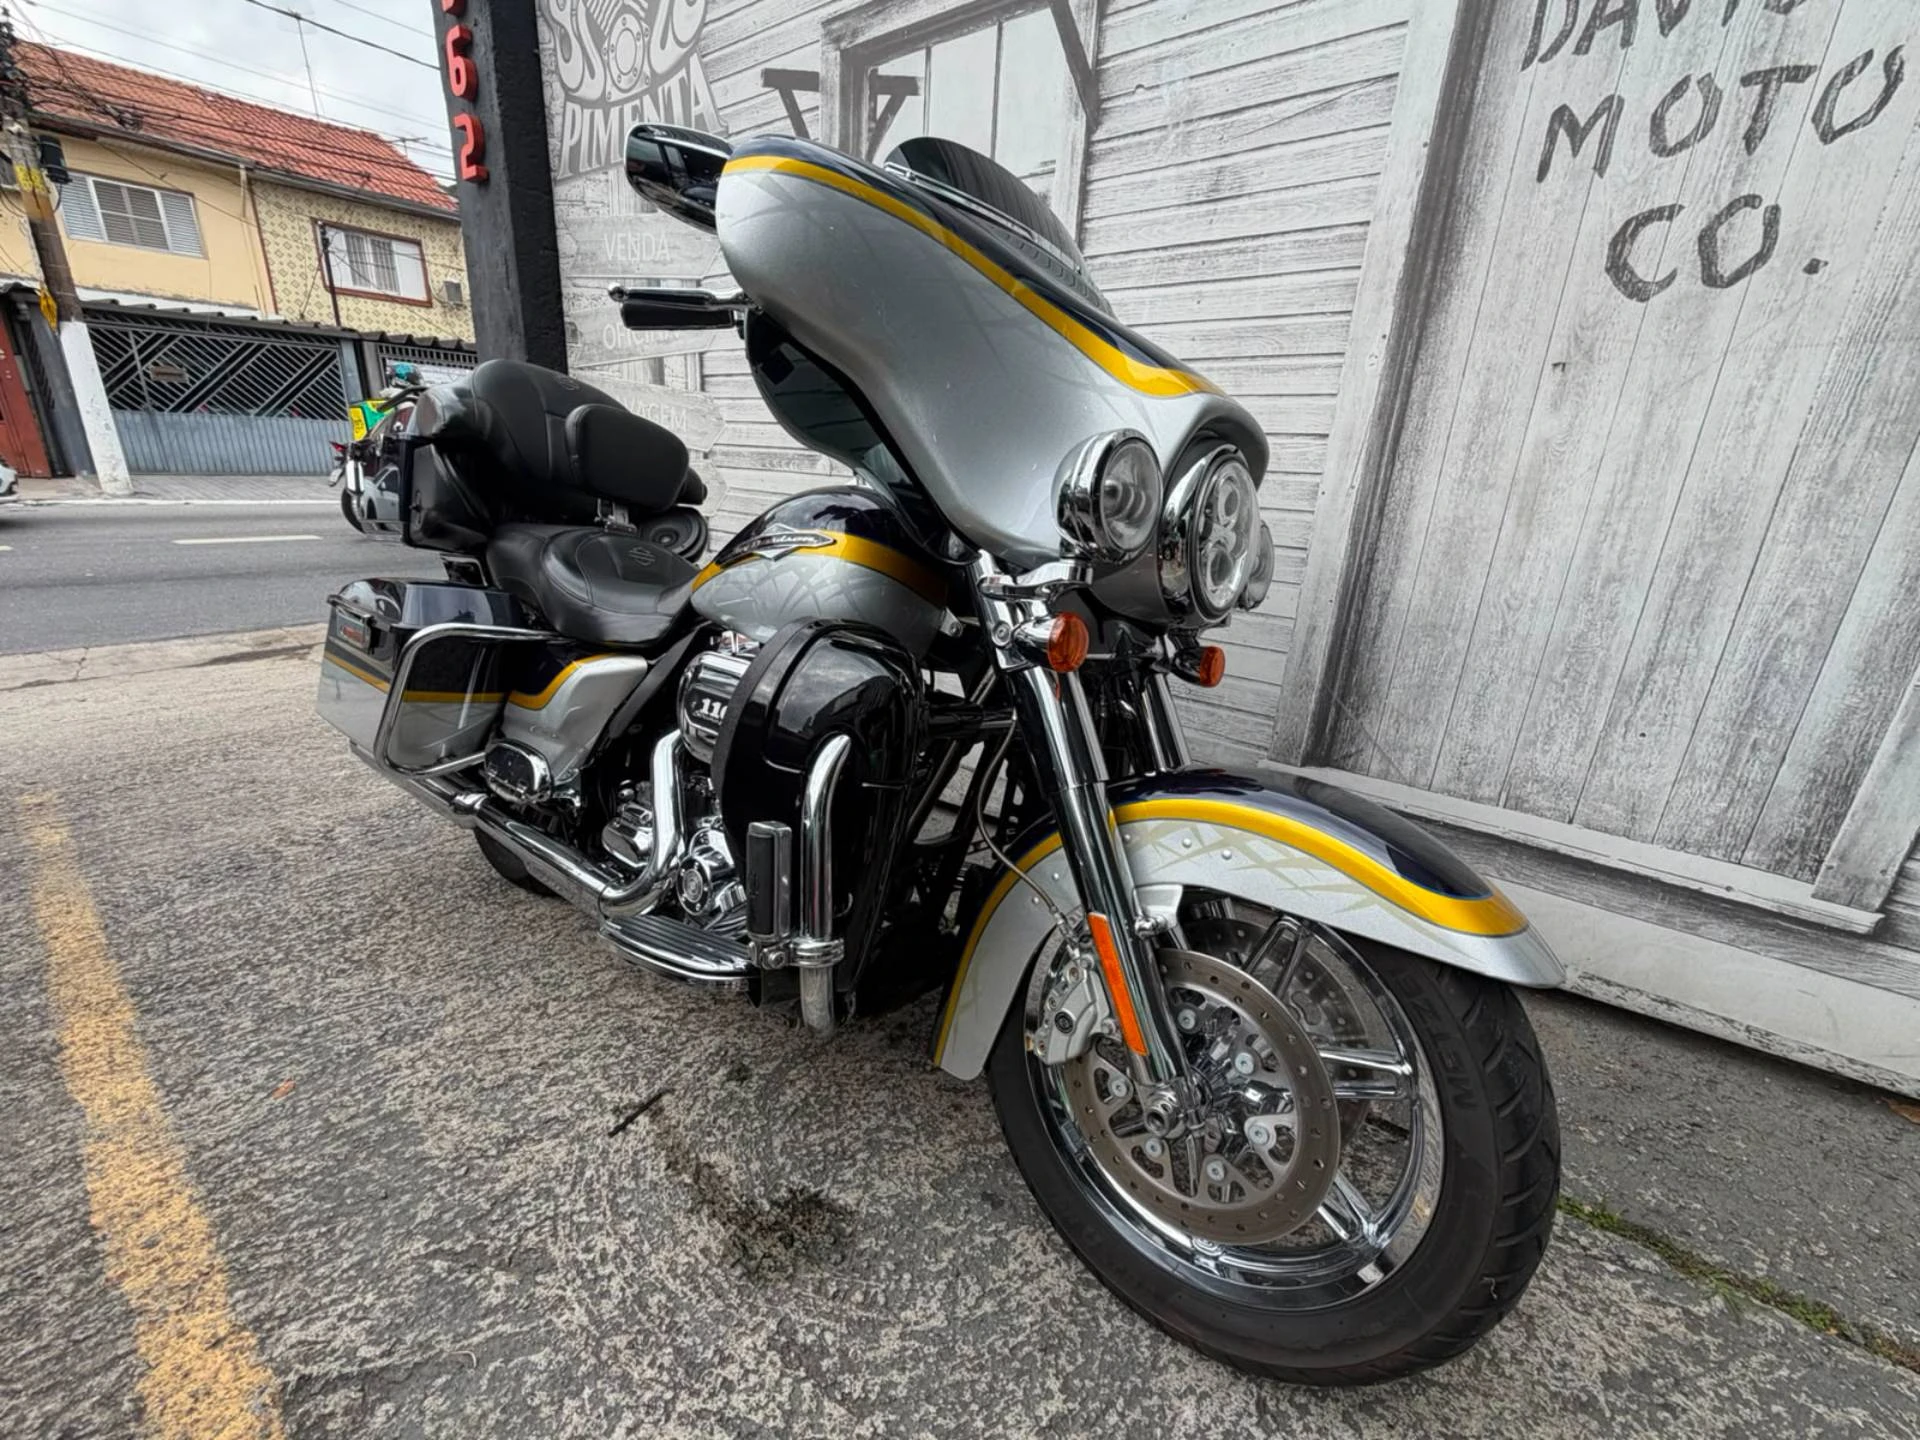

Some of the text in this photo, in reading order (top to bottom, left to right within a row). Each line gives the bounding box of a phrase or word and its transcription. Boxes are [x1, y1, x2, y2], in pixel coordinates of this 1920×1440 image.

[441, 0, 486, 181] 62
[1537, 45, 1905, 183] MOTO
[603, 230, 671, 261] VENDA
[1605, 193, 1828, 302] CO.
